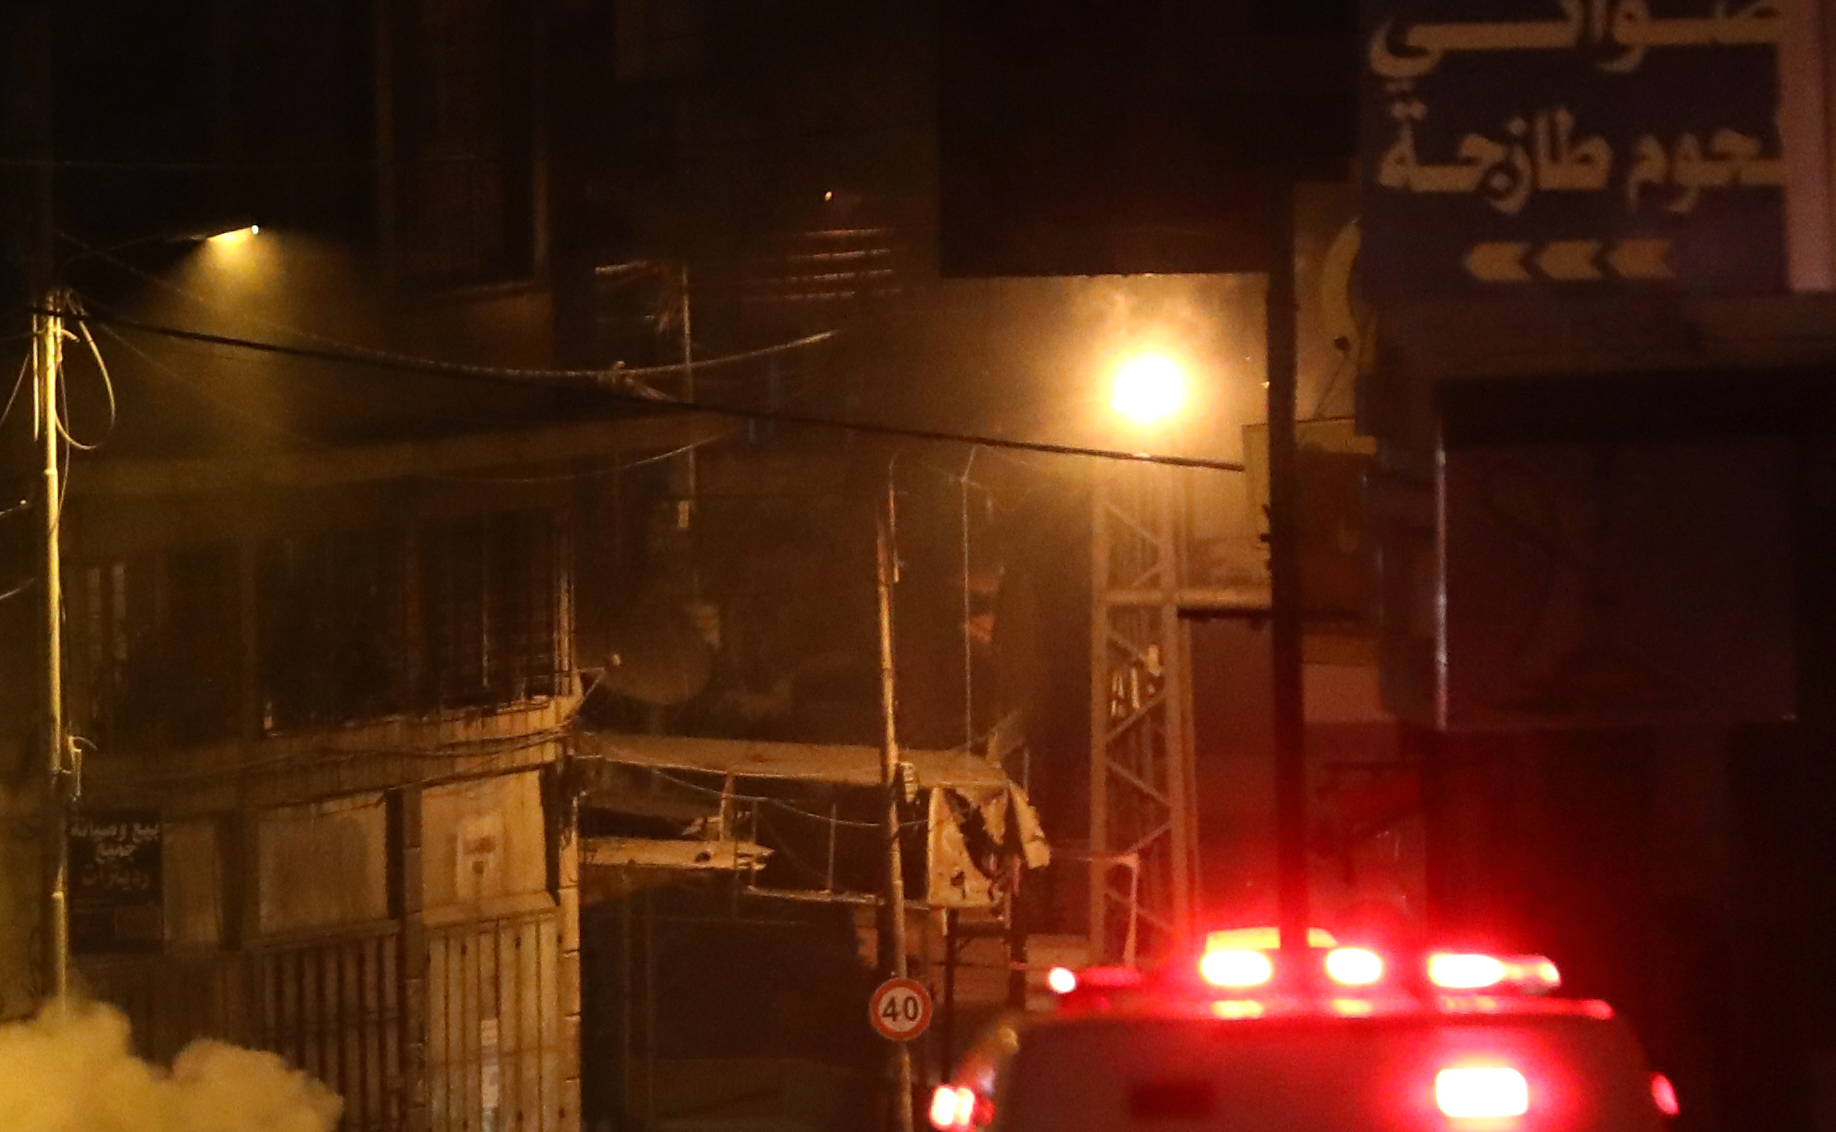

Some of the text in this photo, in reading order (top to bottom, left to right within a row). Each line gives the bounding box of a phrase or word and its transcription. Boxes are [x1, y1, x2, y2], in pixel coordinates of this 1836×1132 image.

[1379, 102, 1781, 215] حوم طازجة
[882, 996, 919, 1022] 40
